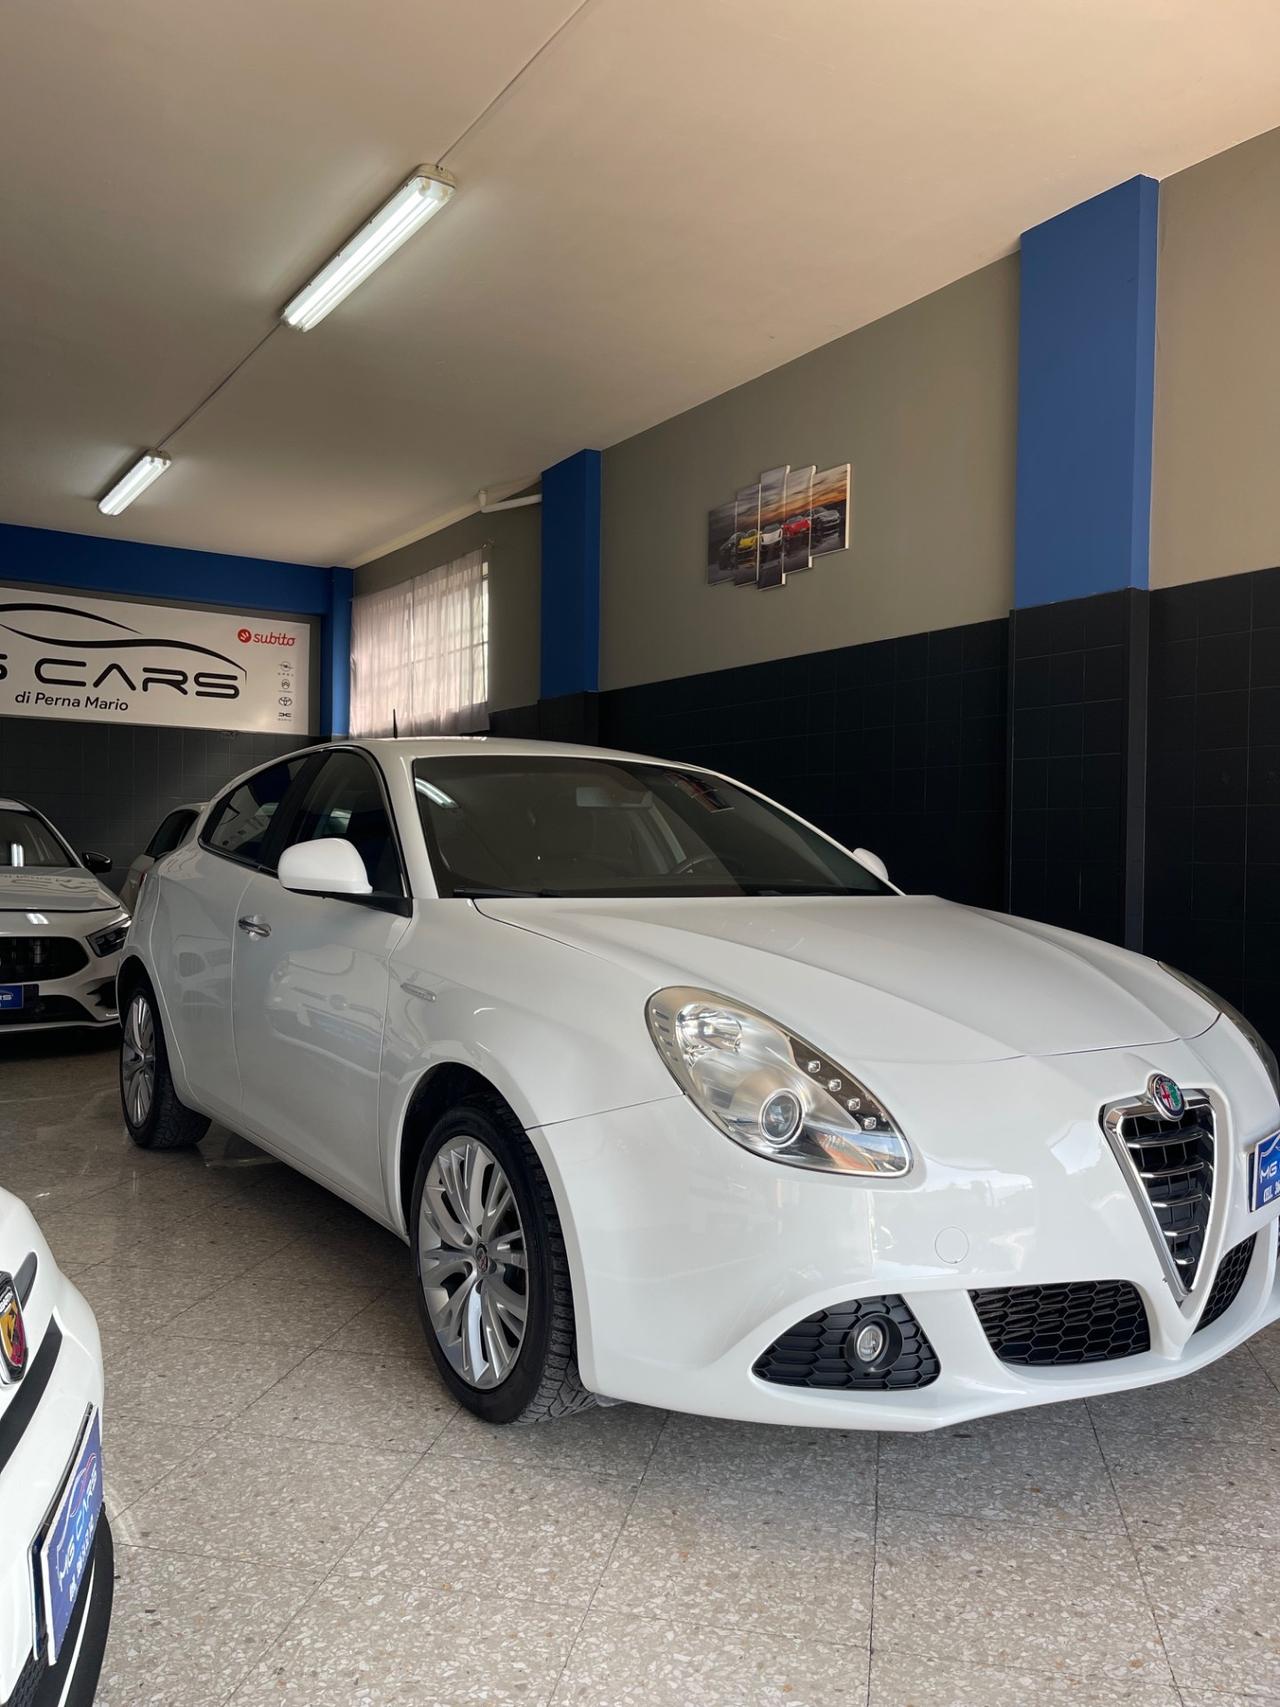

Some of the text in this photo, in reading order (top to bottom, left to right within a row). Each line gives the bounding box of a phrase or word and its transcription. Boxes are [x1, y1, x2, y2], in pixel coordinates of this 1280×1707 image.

[253, 632, 296, 646] subito
[34, 658, 240, 699] CARS
[15, 691, 129, 711] di Perna Mario
